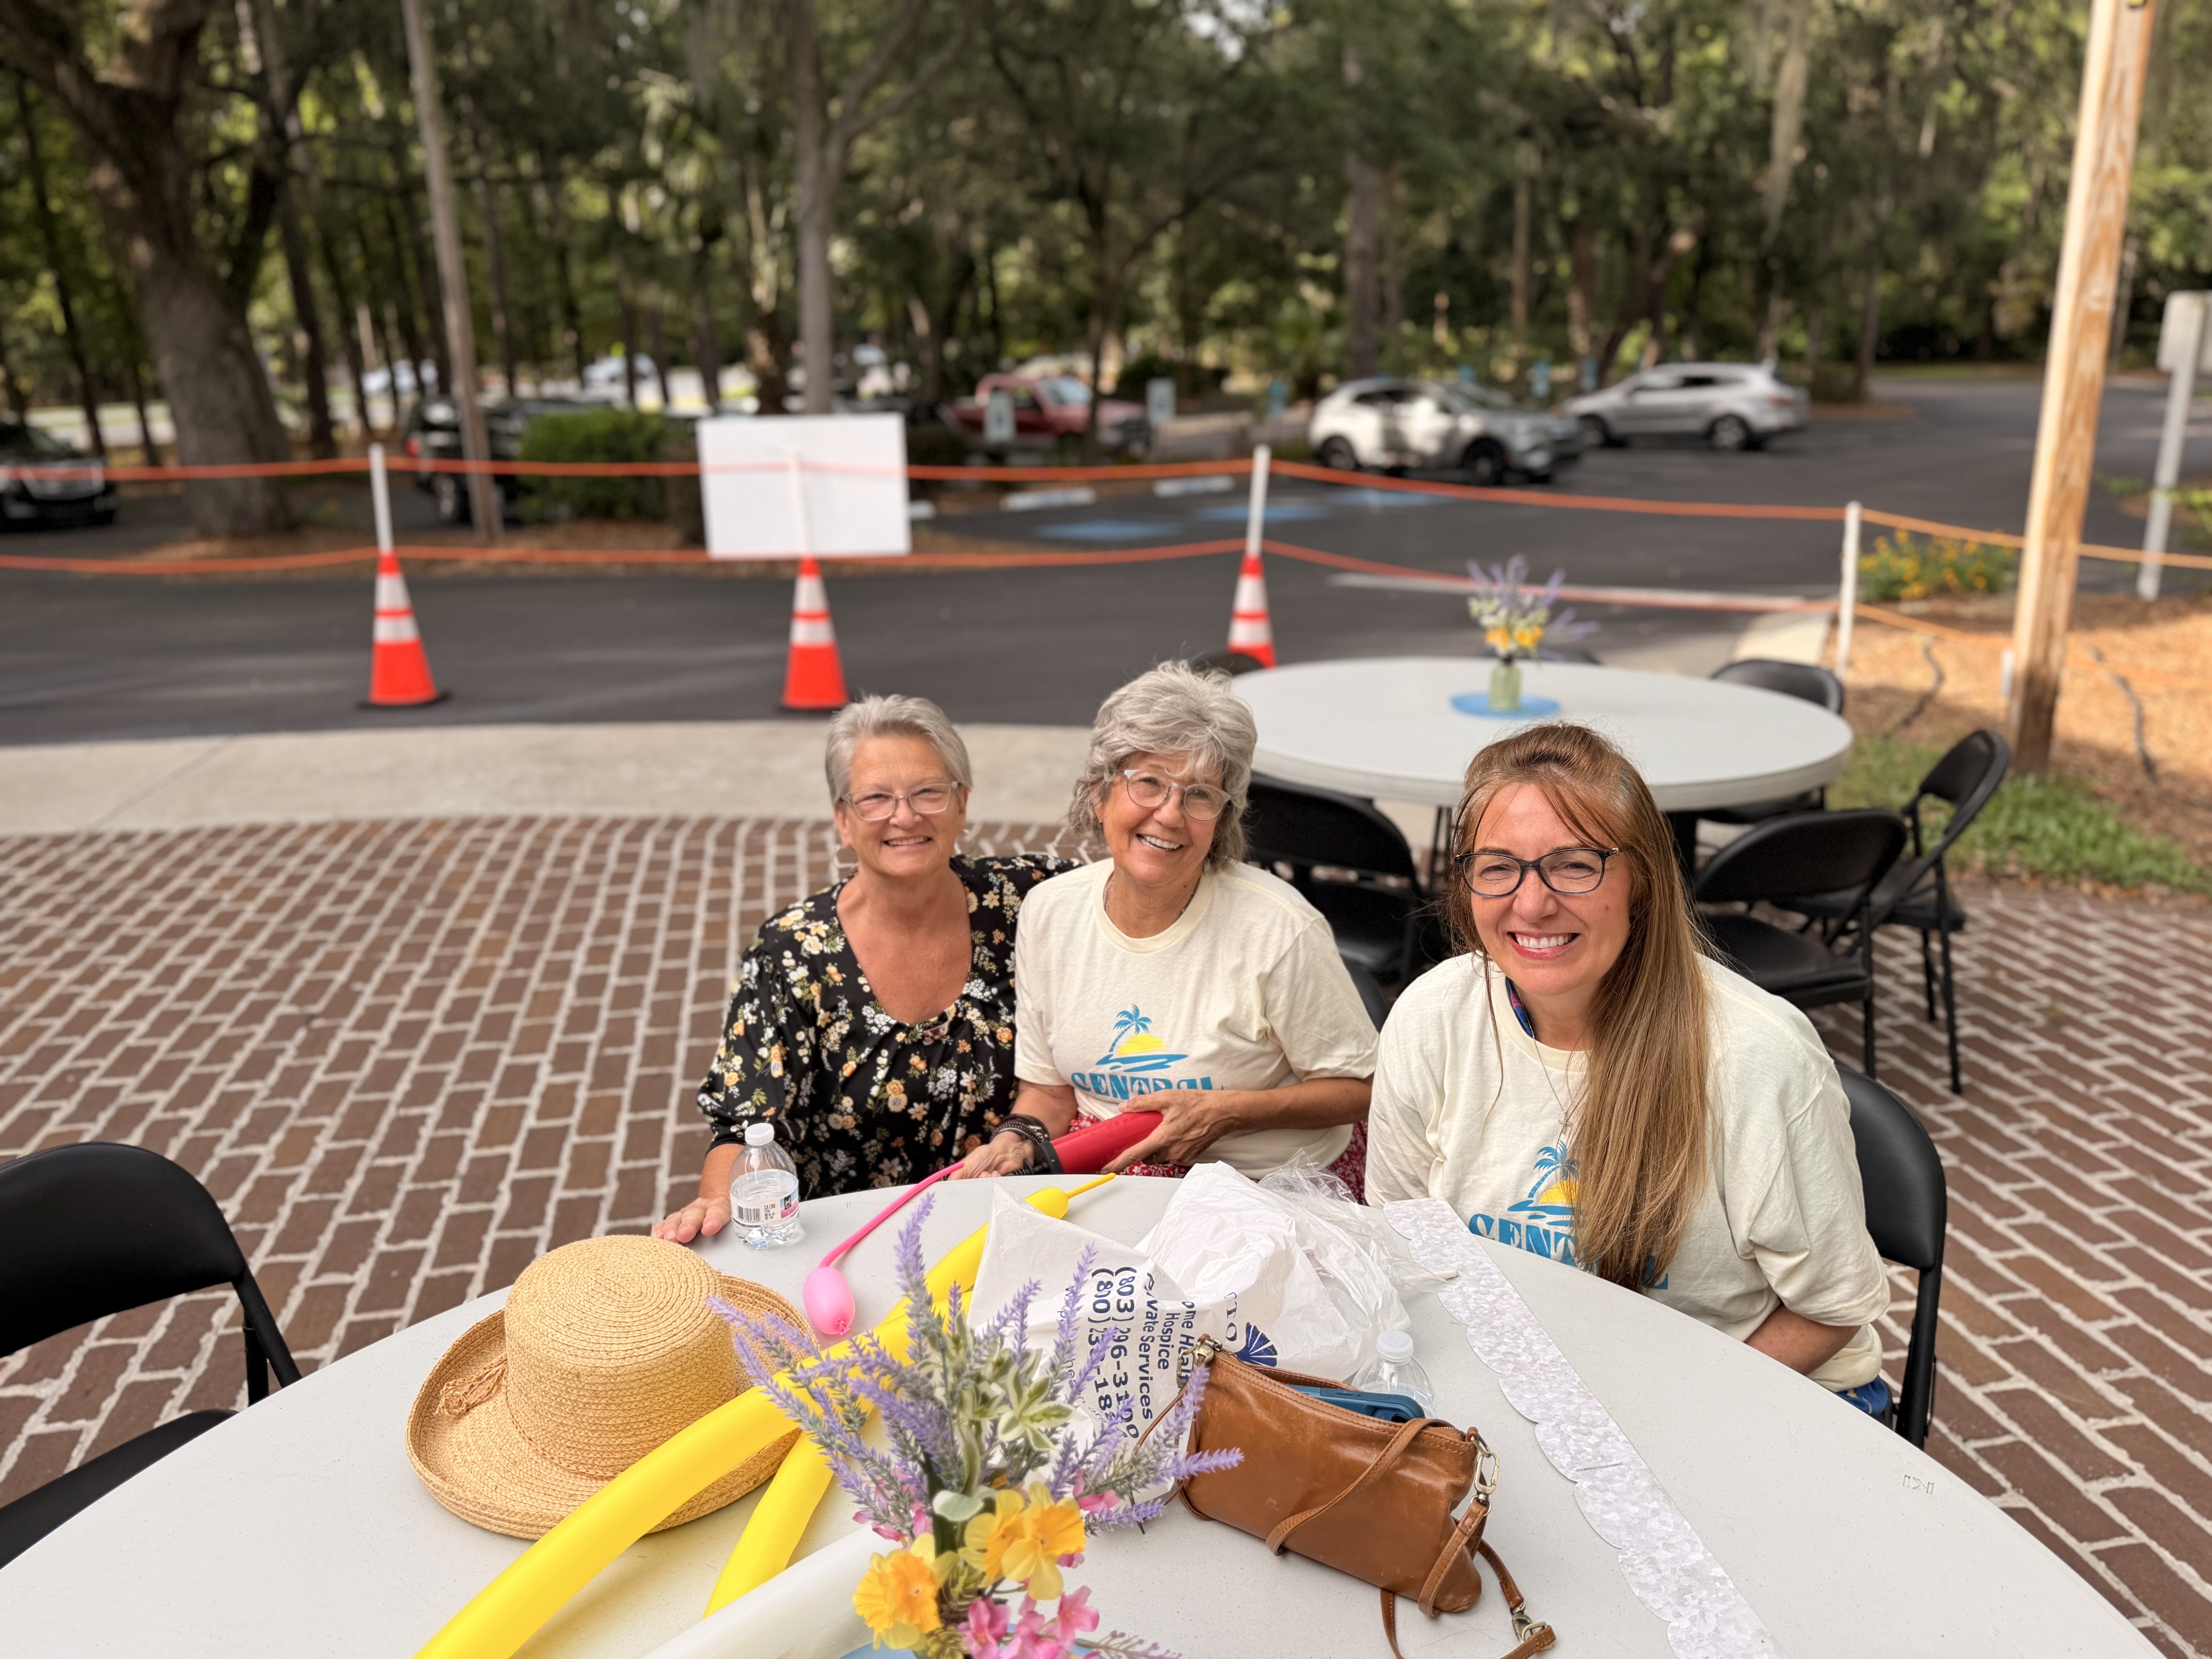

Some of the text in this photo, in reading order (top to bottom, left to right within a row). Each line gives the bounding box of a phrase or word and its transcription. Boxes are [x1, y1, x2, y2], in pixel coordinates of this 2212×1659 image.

[1469, 1214, 1668, 1290] CENTL
[1088, 1268, 1114, 1323] (800)
[1111, 1267, 1137, 1322] (803)
[1158, 1313, 1181, 1370] Hospice
[1139, 1336, 1155, 1420] Services
